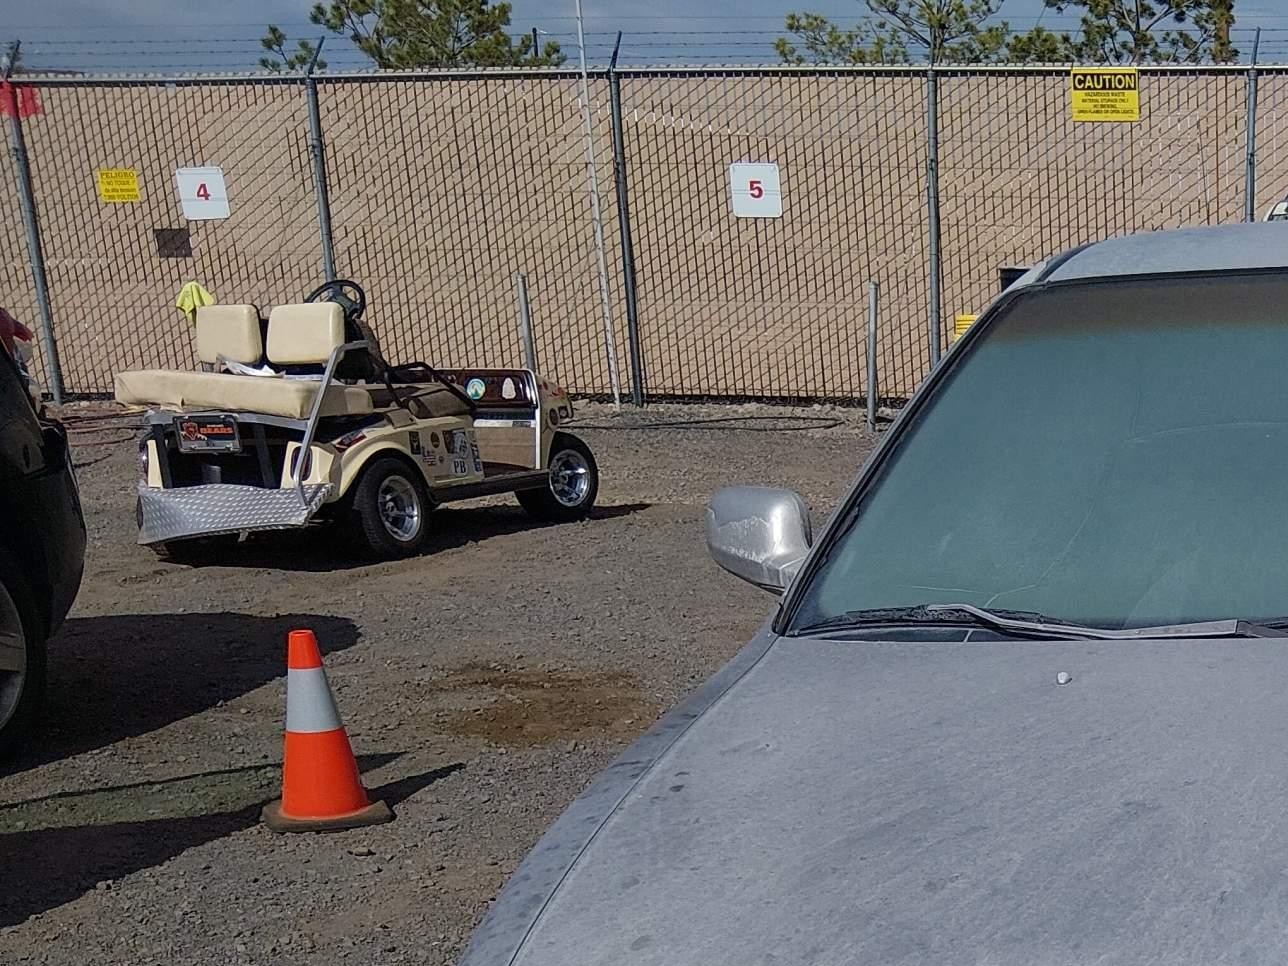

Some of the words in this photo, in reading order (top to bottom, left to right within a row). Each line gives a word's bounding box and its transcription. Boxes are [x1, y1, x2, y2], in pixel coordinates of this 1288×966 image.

[1075, 75, 1135, 89] CAUTION
[196, 183, 212, 201] 4
[749, 180, 764, 199] 5
[453, 460, 467, 474] PB
